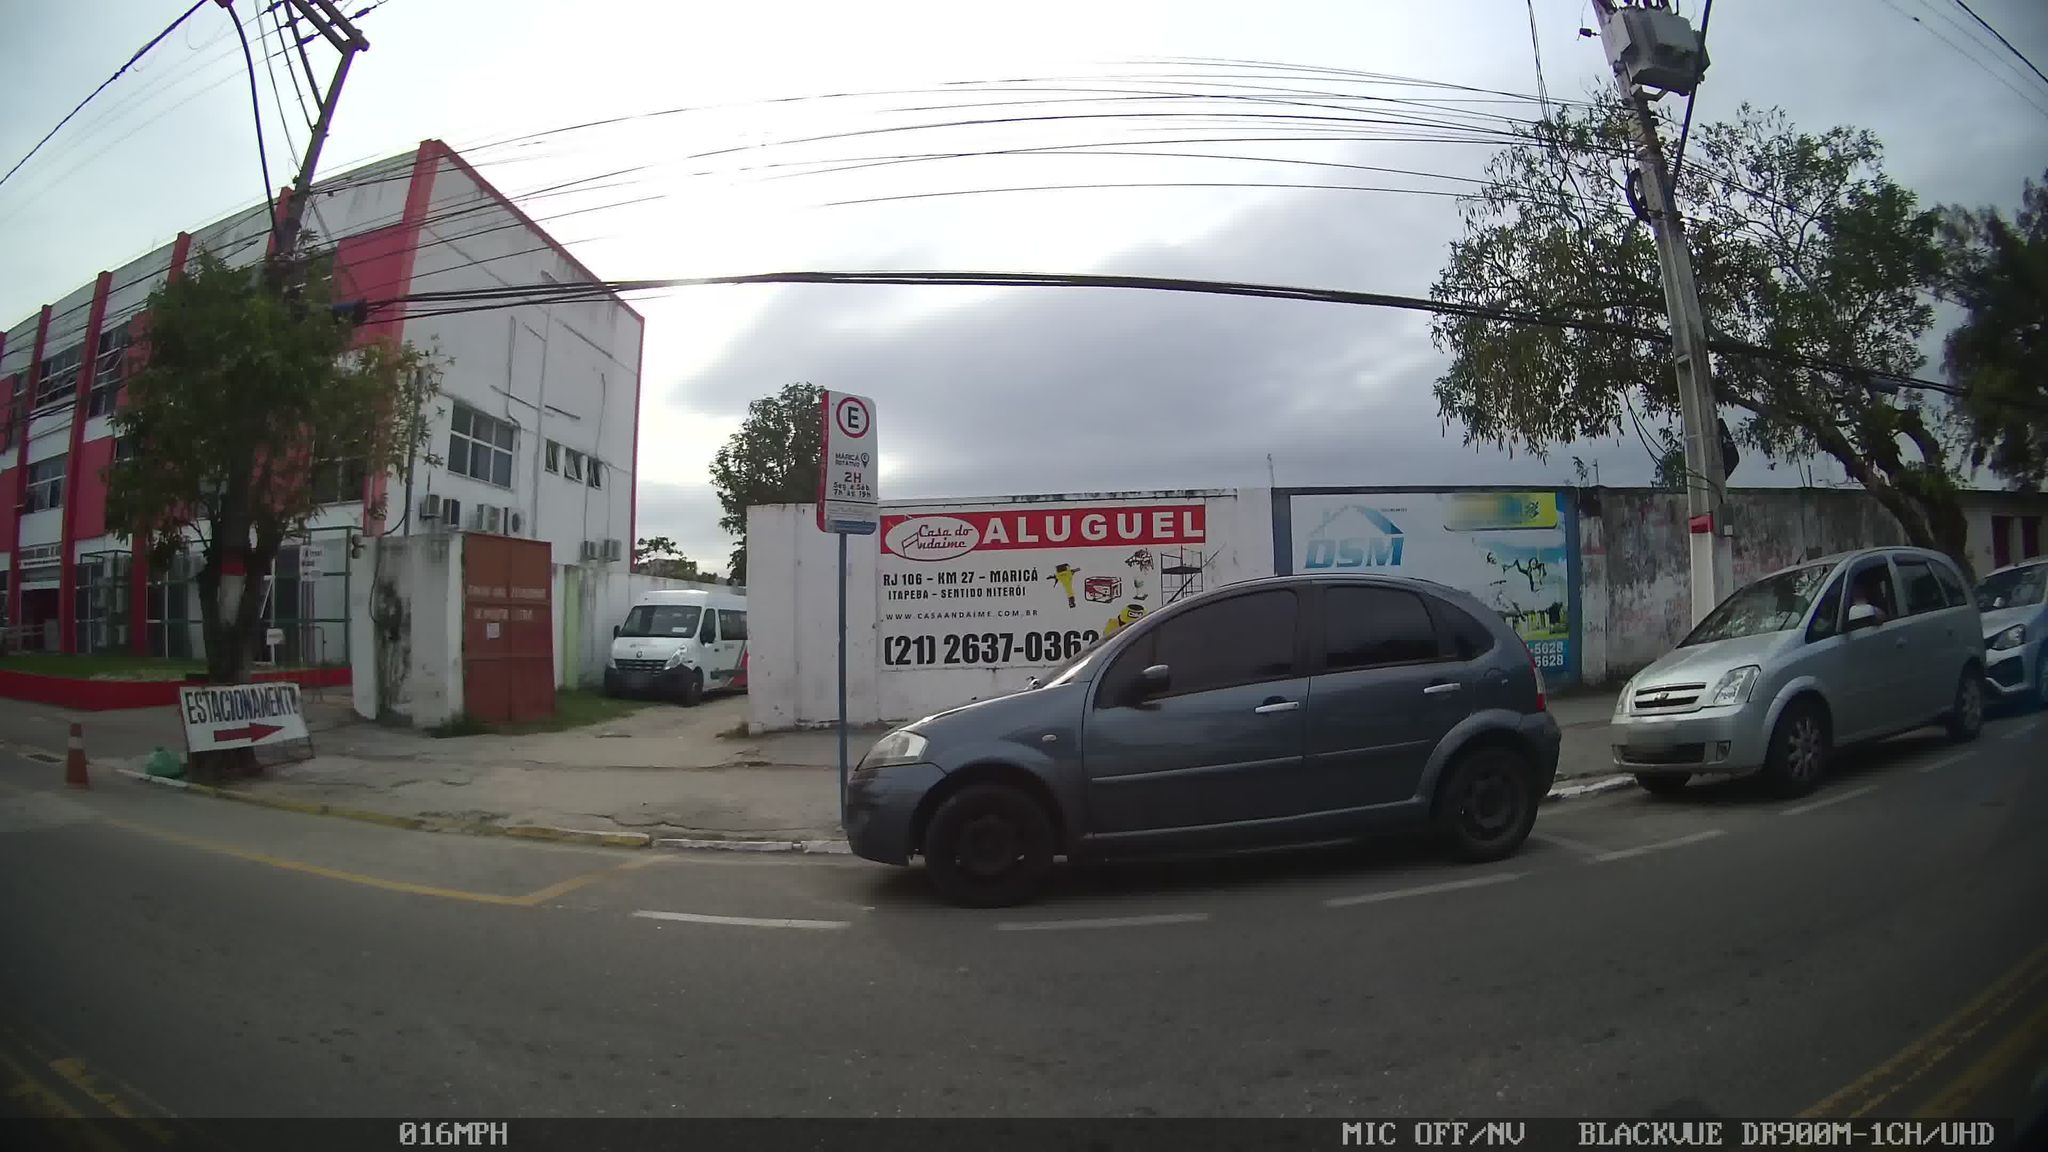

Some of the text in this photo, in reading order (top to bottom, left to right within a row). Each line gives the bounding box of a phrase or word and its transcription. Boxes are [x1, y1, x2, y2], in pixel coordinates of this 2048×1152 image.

[847, 406, 859, 429] E
[844, 471, 862, 483] 2H
[919, 524, 974, 537] Casa do
[981, 511, 1204, 544] ALUGUEL
[883, 574, 898, 586] RJ
[902, 573, 923, 586] 106
[938, 571, 957, 585] KM
[961, 571, 975, 584] 27
[990, 567, 1039, 583] MARICÁ
[888, 590, 929, 600] ITAPEBA
[941, 588, 983, 599] SENTIDO
[986, 584, 1026, 597] NITERÓI
[884, 635, 936, 666] (21)
